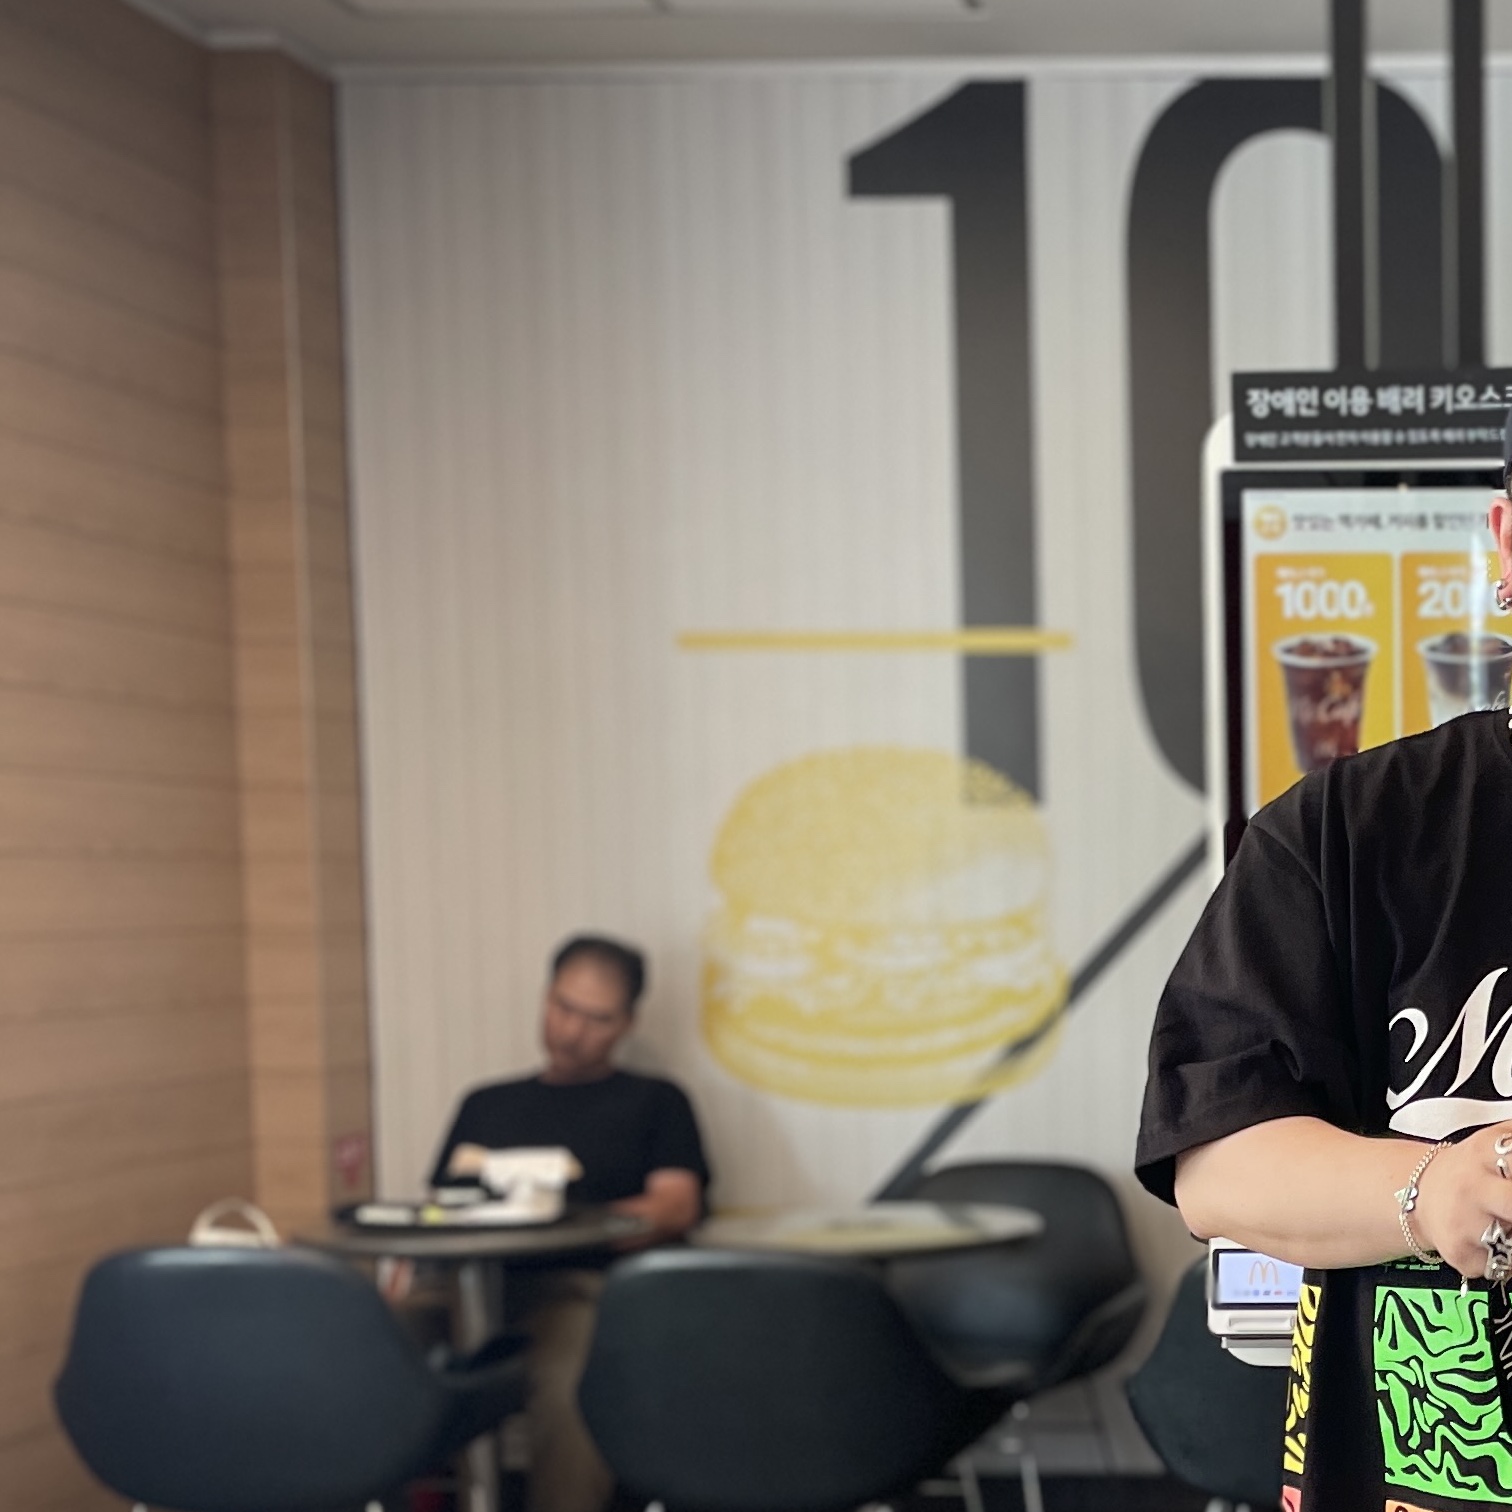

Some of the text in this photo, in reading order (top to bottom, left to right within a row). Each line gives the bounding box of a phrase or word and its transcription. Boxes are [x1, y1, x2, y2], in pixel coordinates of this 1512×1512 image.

[1246, 385, 1319, 418] 장애인
[1322, 385, 1373, 417] 이용
[1376, 384, 1425, 415] 배려
